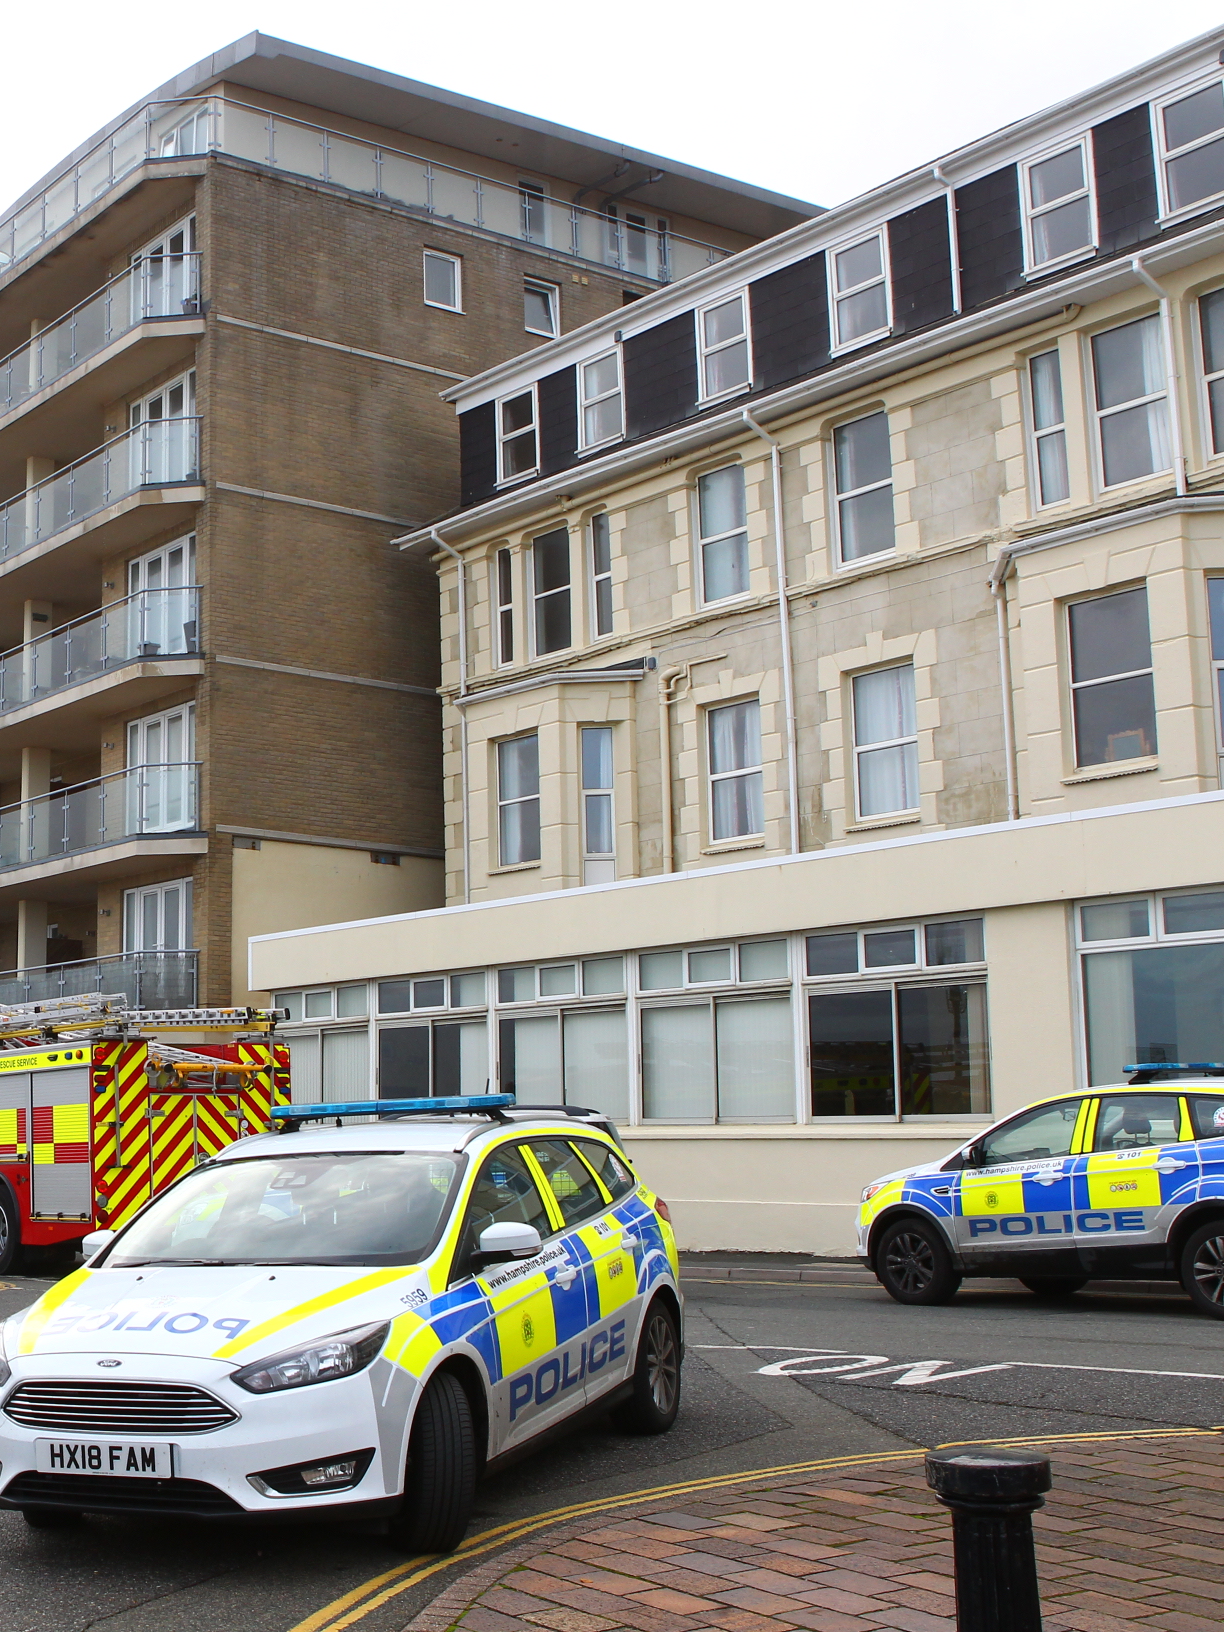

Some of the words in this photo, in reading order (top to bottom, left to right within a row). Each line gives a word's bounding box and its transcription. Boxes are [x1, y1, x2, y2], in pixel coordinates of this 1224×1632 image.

[16, 1057, 37, 1067] SERVICE
[1126, 1151, 1141, 1159] 101
[965, 1160, 1062, 1177] www.hampshire.police.uk
[968, 1210, 1146, 1238] POLICE
[487, 1244, 567, 1290] www.hampshire.police.uk
[399, 1288, 428, 1308] 5959
[509, 1318, 626, 1423] POLICE
[49, 1443, 102, 1470] HX18
[108, 1445, 156, 1473] FAM
